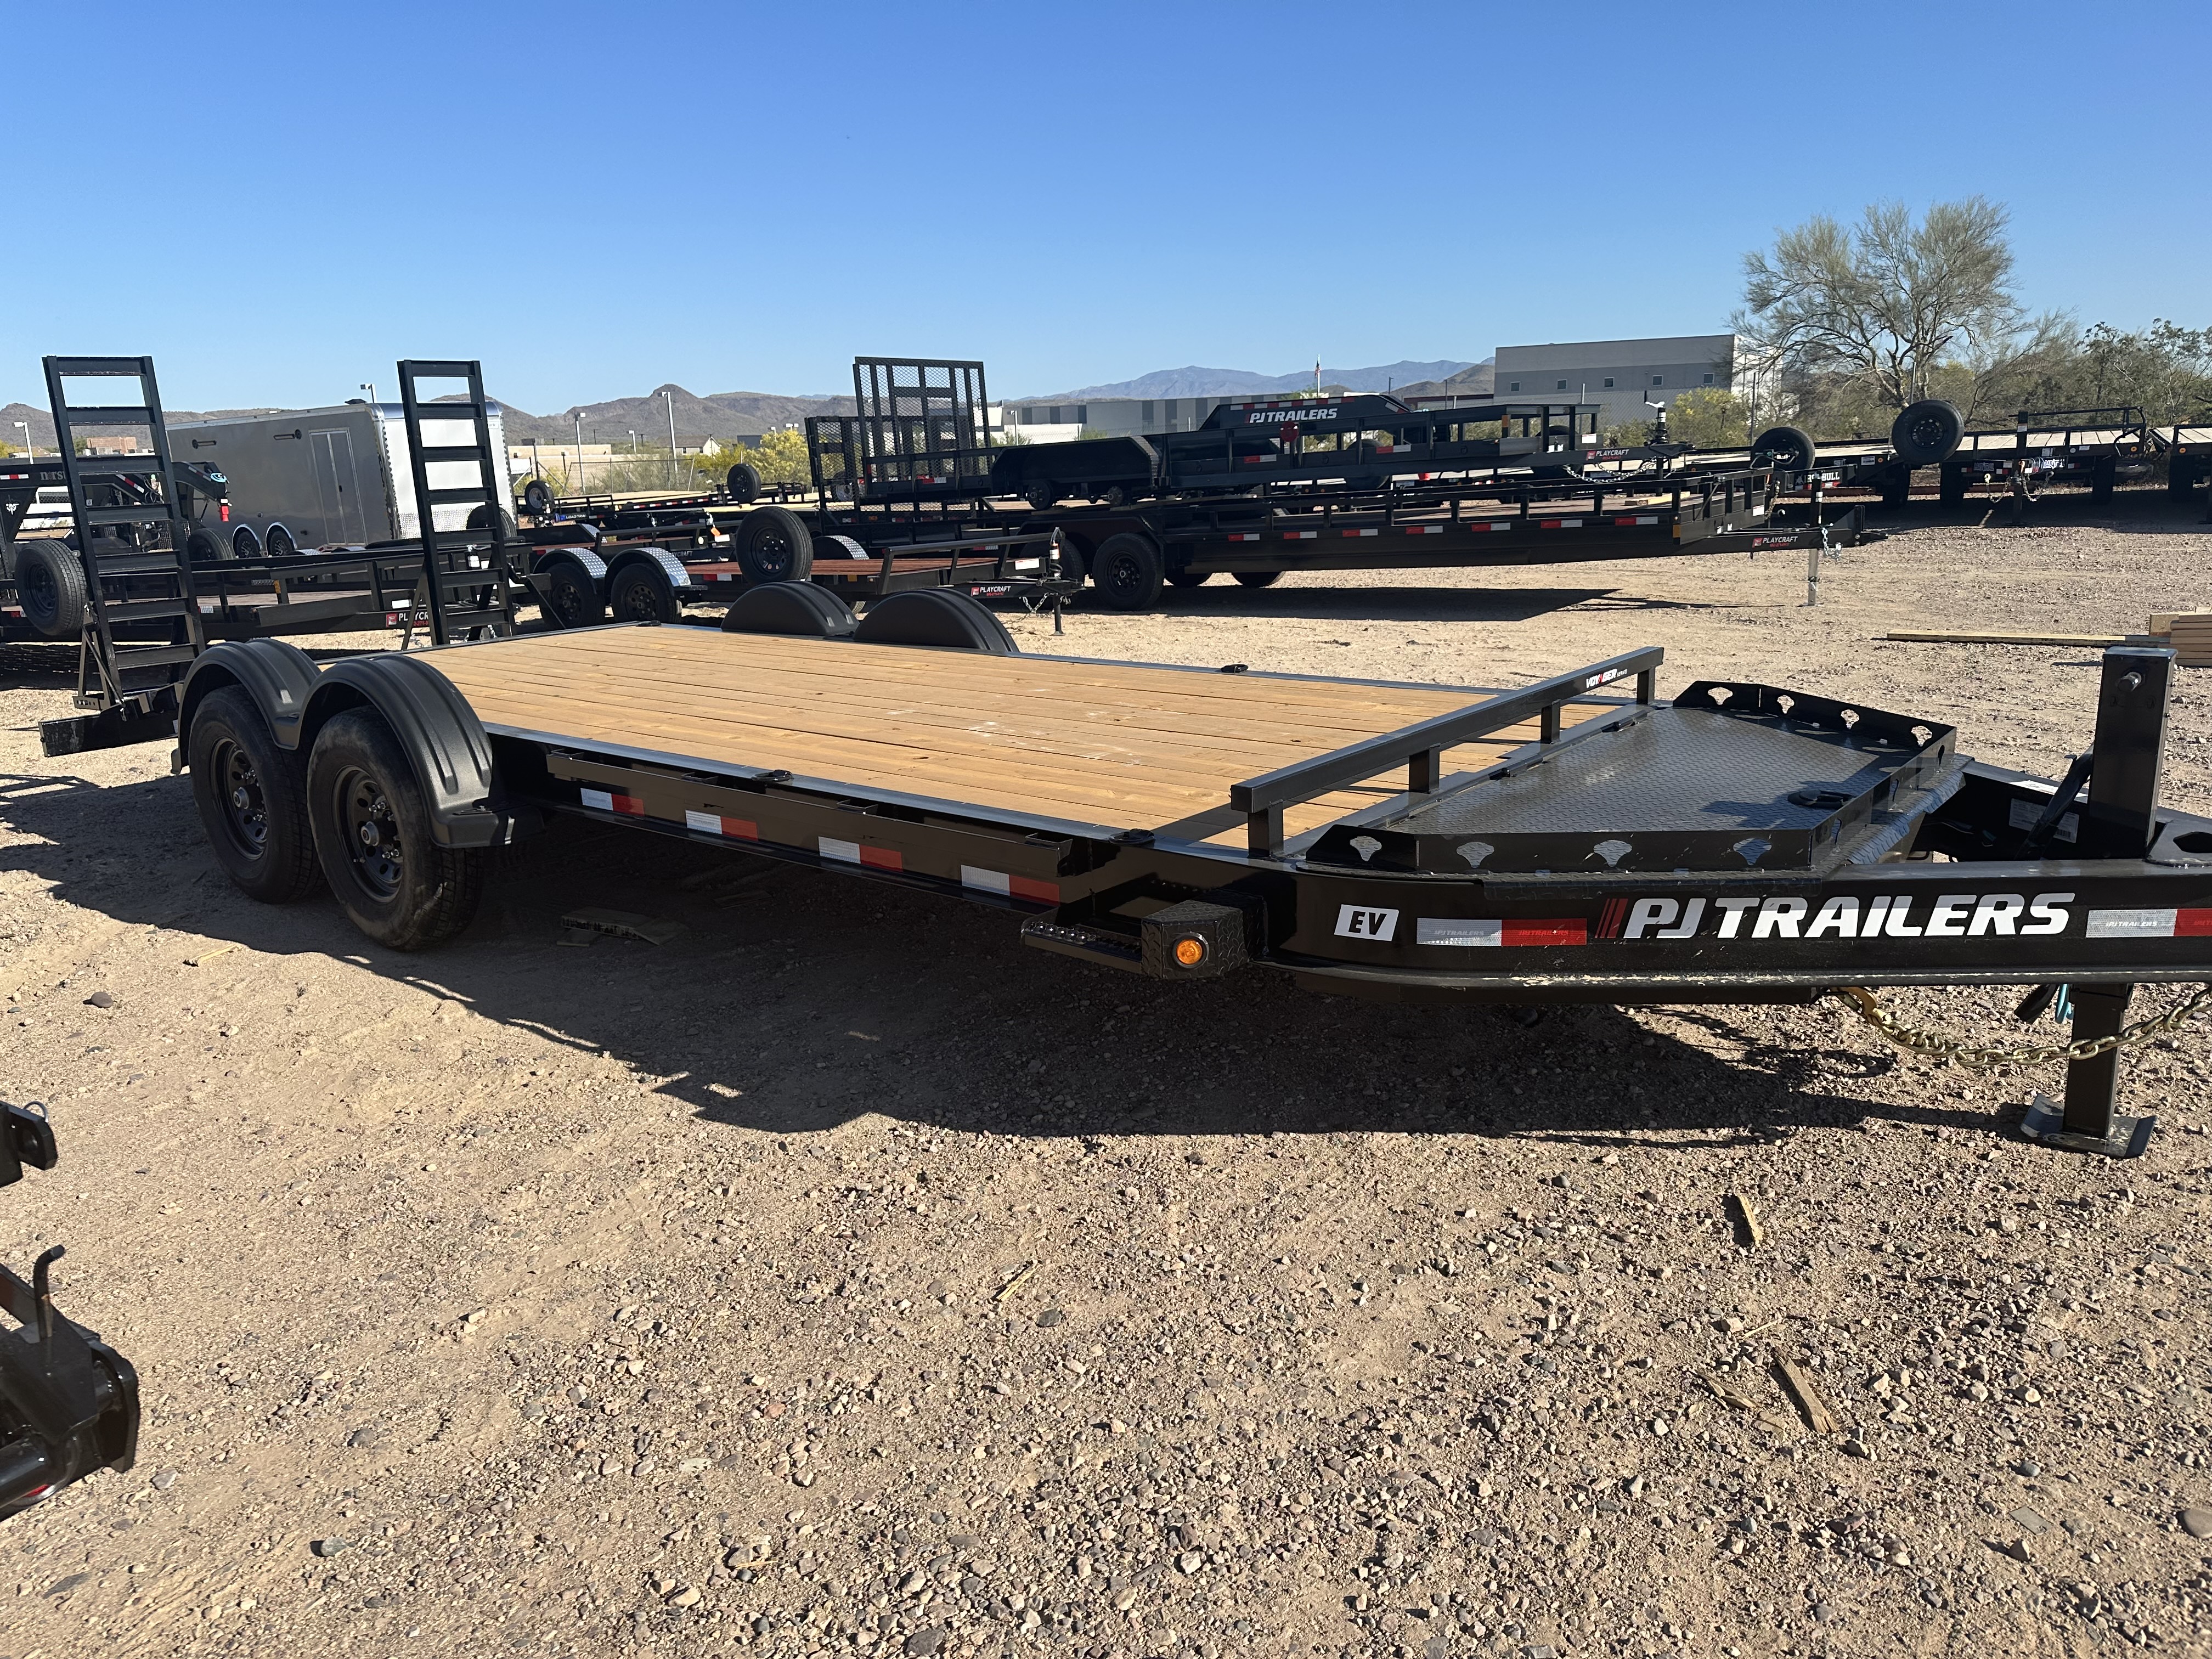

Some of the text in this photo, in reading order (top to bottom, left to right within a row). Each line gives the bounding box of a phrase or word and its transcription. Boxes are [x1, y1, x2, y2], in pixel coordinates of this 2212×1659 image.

[1821, 472, 1839, 481] BULL
[1586, 668, 1617, 689] VOYAGER
[1348, 911, 1387, 935] EV
[1714, 893, 2076, 939] TRAILERS
